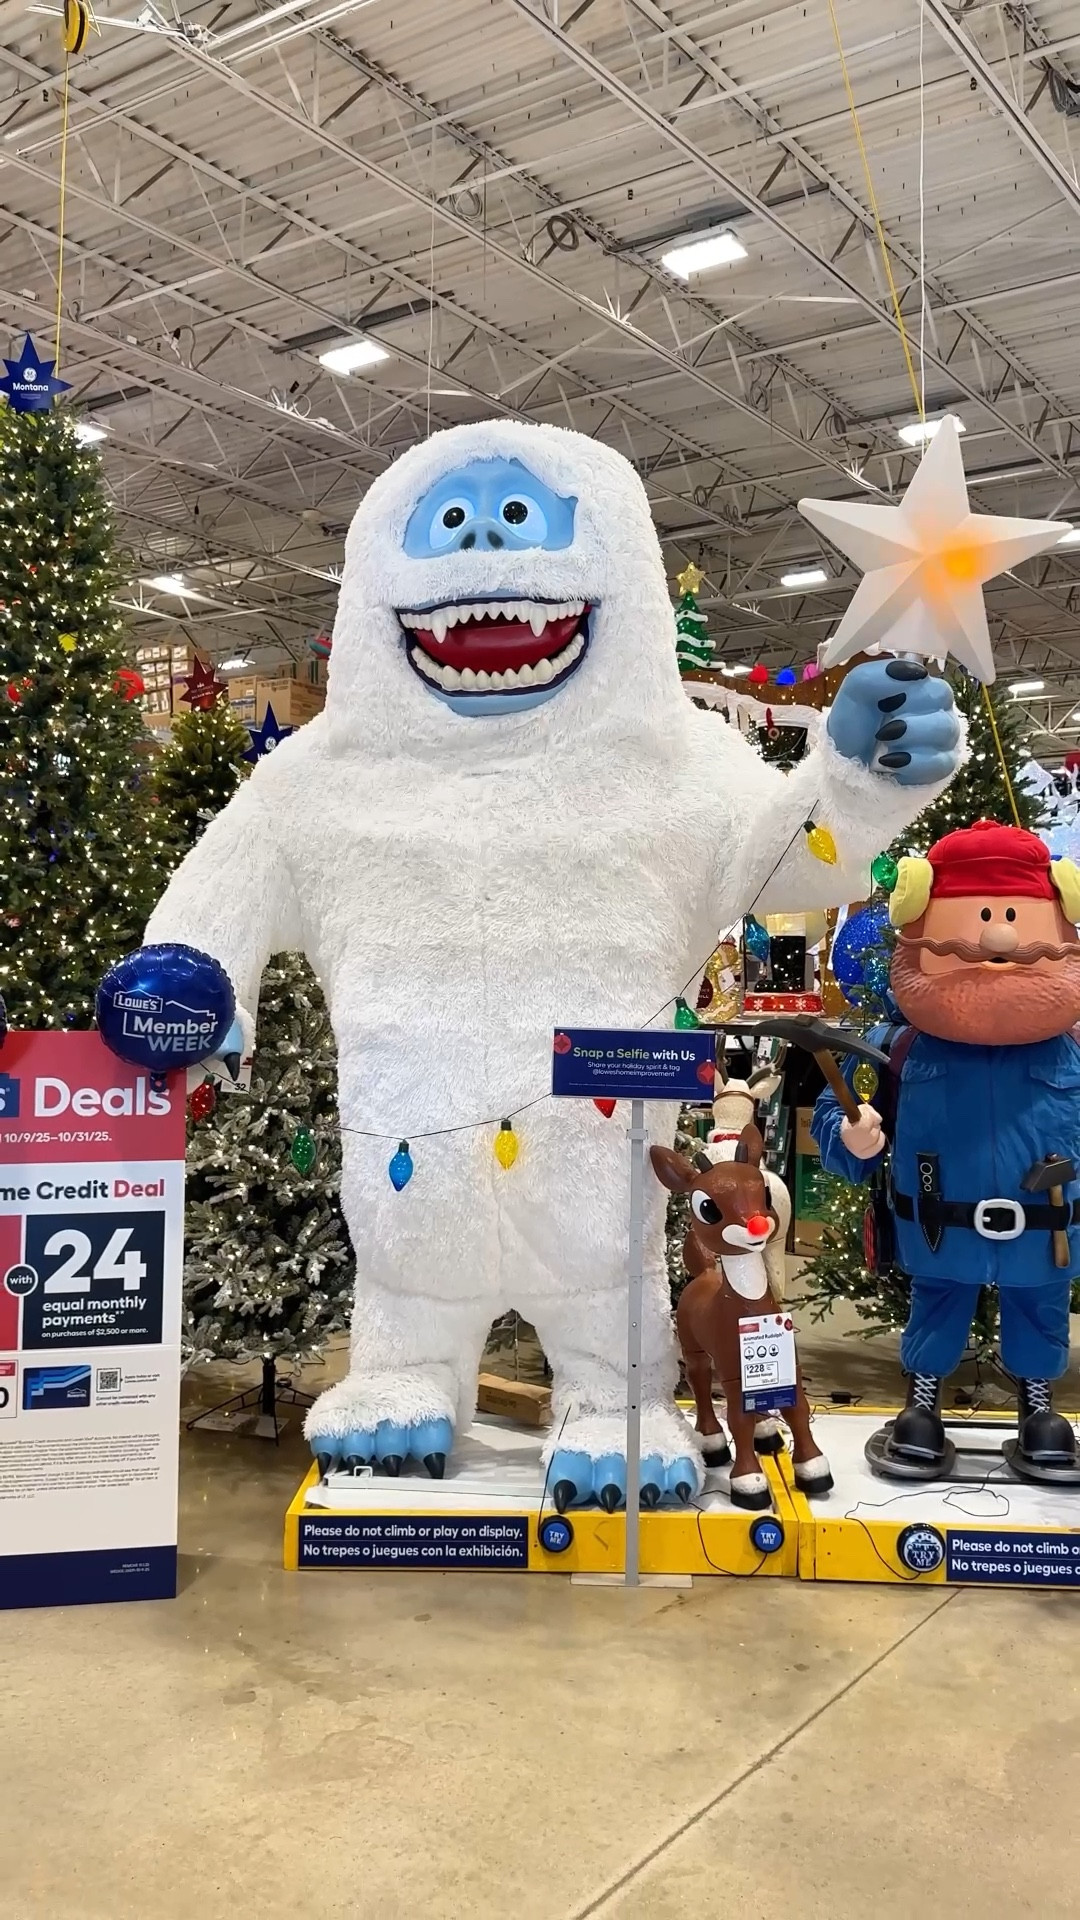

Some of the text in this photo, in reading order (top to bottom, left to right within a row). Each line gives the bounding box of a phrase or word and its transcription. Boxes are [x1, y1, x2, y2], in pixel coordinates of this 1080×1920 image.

[12, 382, 49, 391] Montana
[118, 995, 159, 1010] LOWE'S
[133, 1015, 218, 1035] Member
[147, 1034, 214, 1052] WEEK
[573, 1047, 696, 1061] Snap a Selfie with Us
[593, 1069, 675, 1078] @loweshomeimprovement
[622, 1062, 645, 1070] holiday
[646, 1063, 662, 1071] spirit
[669, 1064, 681, 1072] tag
[34, 1076, 172, 1118] Deals
[36, 1180, 109, 1200] Credit
[114, 1178, 165, 1198] Deal
[44, 1227, 147, 1294] 24
[9, 1275, 33, 1285] with
[42, 1295, 147, 1316] equal monthly
[51, 1329, 86, 1338] purchases
[87, 1328, 96, 1336] of
[96, 1327, 120, 1337] $2,500
[129, 1327, 149, 1335] more.
[746, 1363, 765, 1373] $228
[304, 1525, 523, 1539] Please do not climb or play on display.
[549, 1530, 565, 1538] TRY
[760, 1532, 776, 1540] TRY
[304, 1544, 523, 1558] No trepes o juegues con la exhibición.
[952, 1539, 1080, 1555] Please do not climb o
[911, 1551, 935, 1560] TRY
[916, 1558, 932, 1566] ME
[952, 1559, 969, 1571] No
[971, 1560, 1011, 1574] trepes
[1013, 1563, 1022, 1572] o
[1023, 1561, 1073, 1577] juegues
